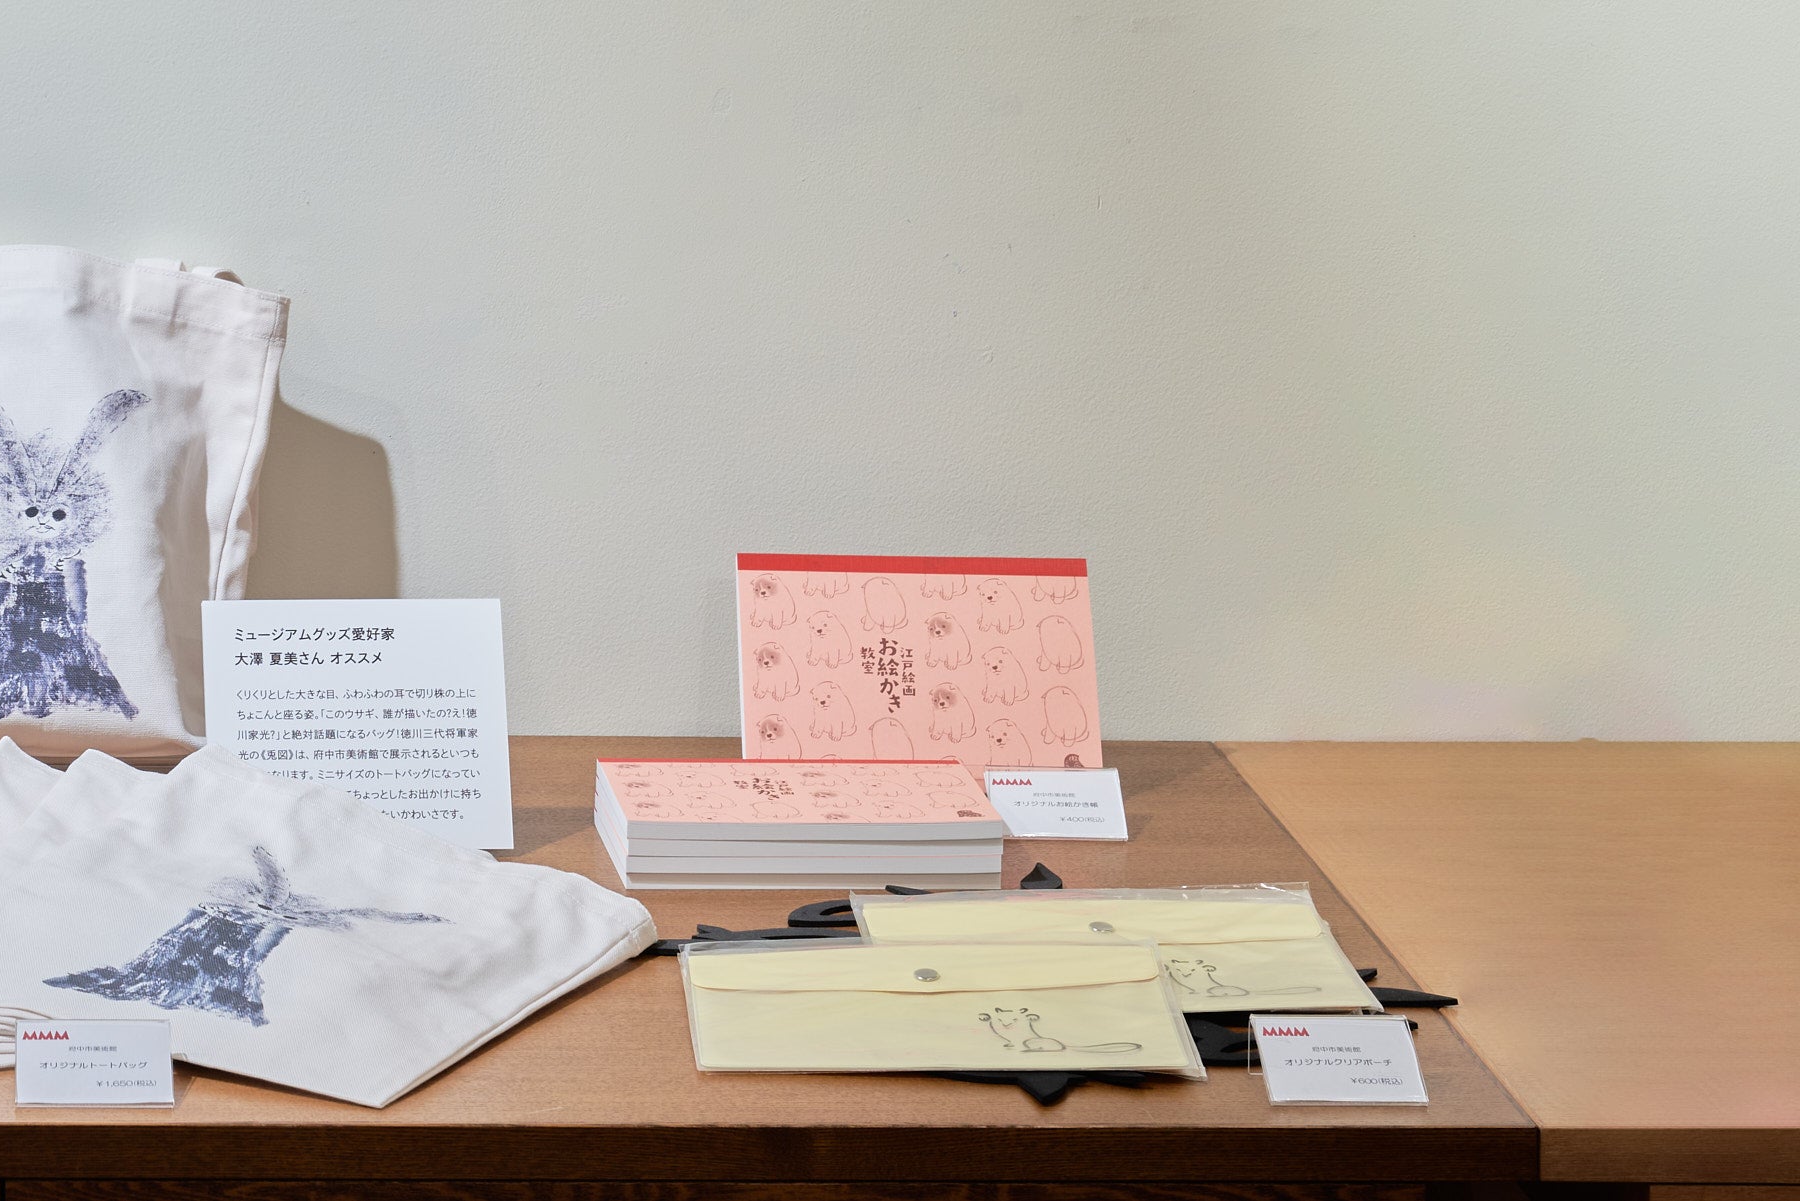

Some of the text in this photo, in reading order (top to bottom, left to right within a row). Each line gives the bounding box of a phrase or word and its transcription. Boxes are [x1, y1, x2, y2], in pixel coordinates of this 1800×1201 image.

[235, 627, 394, 641] ミュージアムグッズ愛好家
[235, 652, 382, 666] 大澤 夏美さん オススメ
[861, 647, 875, 674] 教室
[877, 636, 901, 714] お絵かき
[901, 648, 915, 696] 江戸絵画
[237, 688, 476, 700] くりくりとした大きな目、ふわふわの耳で切り株の上に
[346, 788, 481, 799] ちょっとしたお出かけに持ち
[381, 809, 463, 819] いかわいさです。
